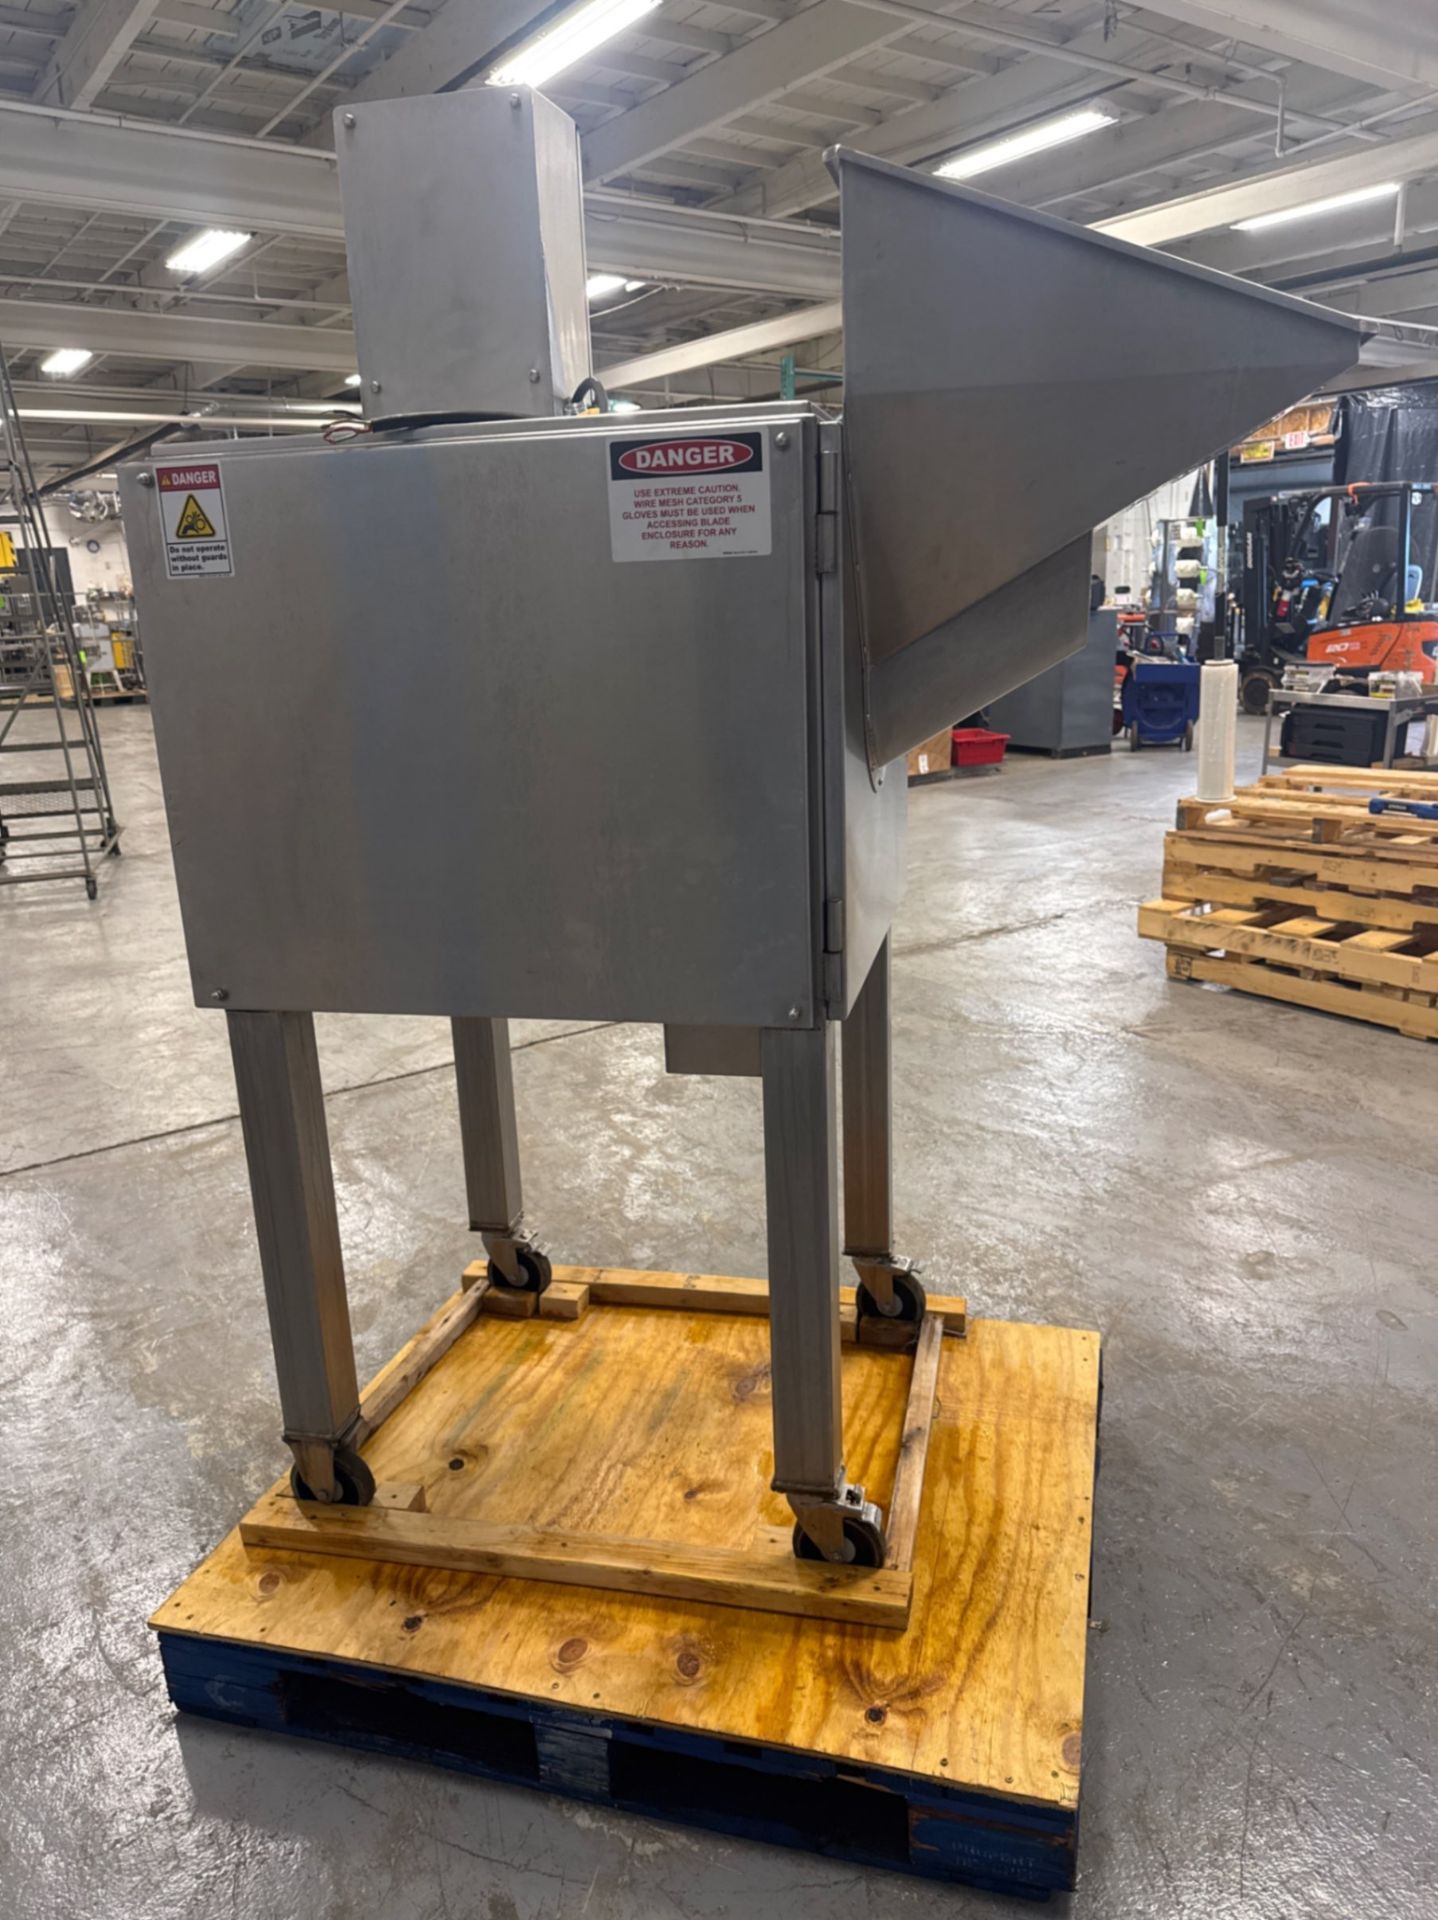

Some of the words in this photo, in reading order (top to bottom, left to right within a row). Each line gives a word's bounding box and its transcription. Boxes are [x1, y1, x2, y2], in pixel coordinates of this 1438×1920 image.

[636, 445, 735, 468] DANGER
[172, 471, 216, 485] DANGER
[634, 488, 652, 498] USE
[654, 487, 696, 497] EXTREME
[634, 499, 656, 508] WIRE
[659, 497, 684, 507] MESH
[686, 495, 733, 506] CATEGORY
[622, 510, 658, 520] GLOVES
[660, 509, 685, 518] MUST
[687, 508, 700, 516] BE
[702, 506, 726, 515] USED
[728, 505, 755, 514] WHEN
[647, 518, 698, 528] ACCESSING
[700, 517, 730, 526] BLADE
[641, 530, 695, 540] ENCLOSURE
[698, 529, 716, 537] FOR
[718, 528, 737, 536] ANY
[196, 544, 225, 553] operate
[202, 553, 227, 562] guards
